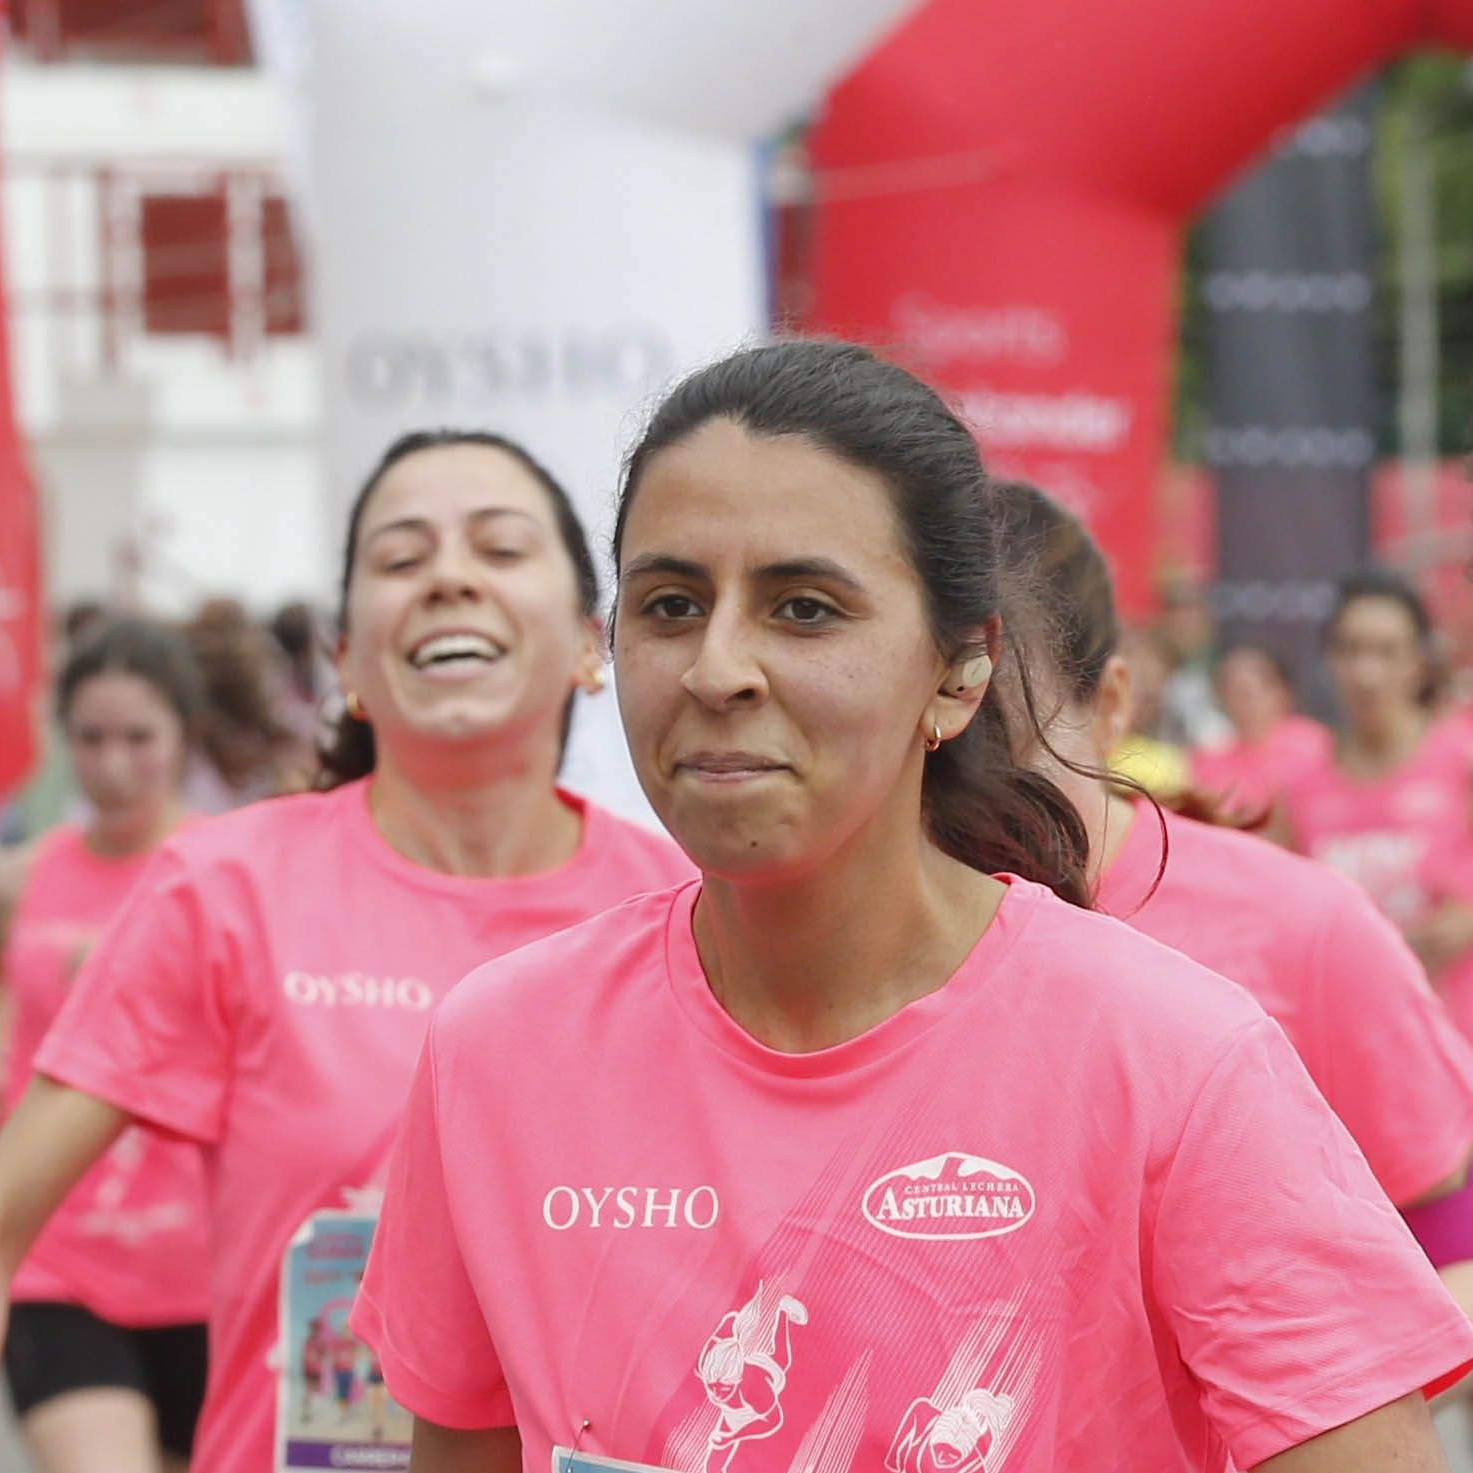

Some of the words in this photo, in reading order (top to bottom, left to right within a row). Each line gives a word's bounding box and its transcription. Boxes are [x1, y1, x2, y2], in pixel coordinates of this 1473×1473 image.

[283, 971, 432, 1012] OYSHO
[876, 1186, 1025, 1220] ASTURIANA
[904, 1182, 958, 1195] CENTRAL
[962, 1181, 1020, 1192] LECHERA
[542, 1185, 720, 1230] OYSHO
